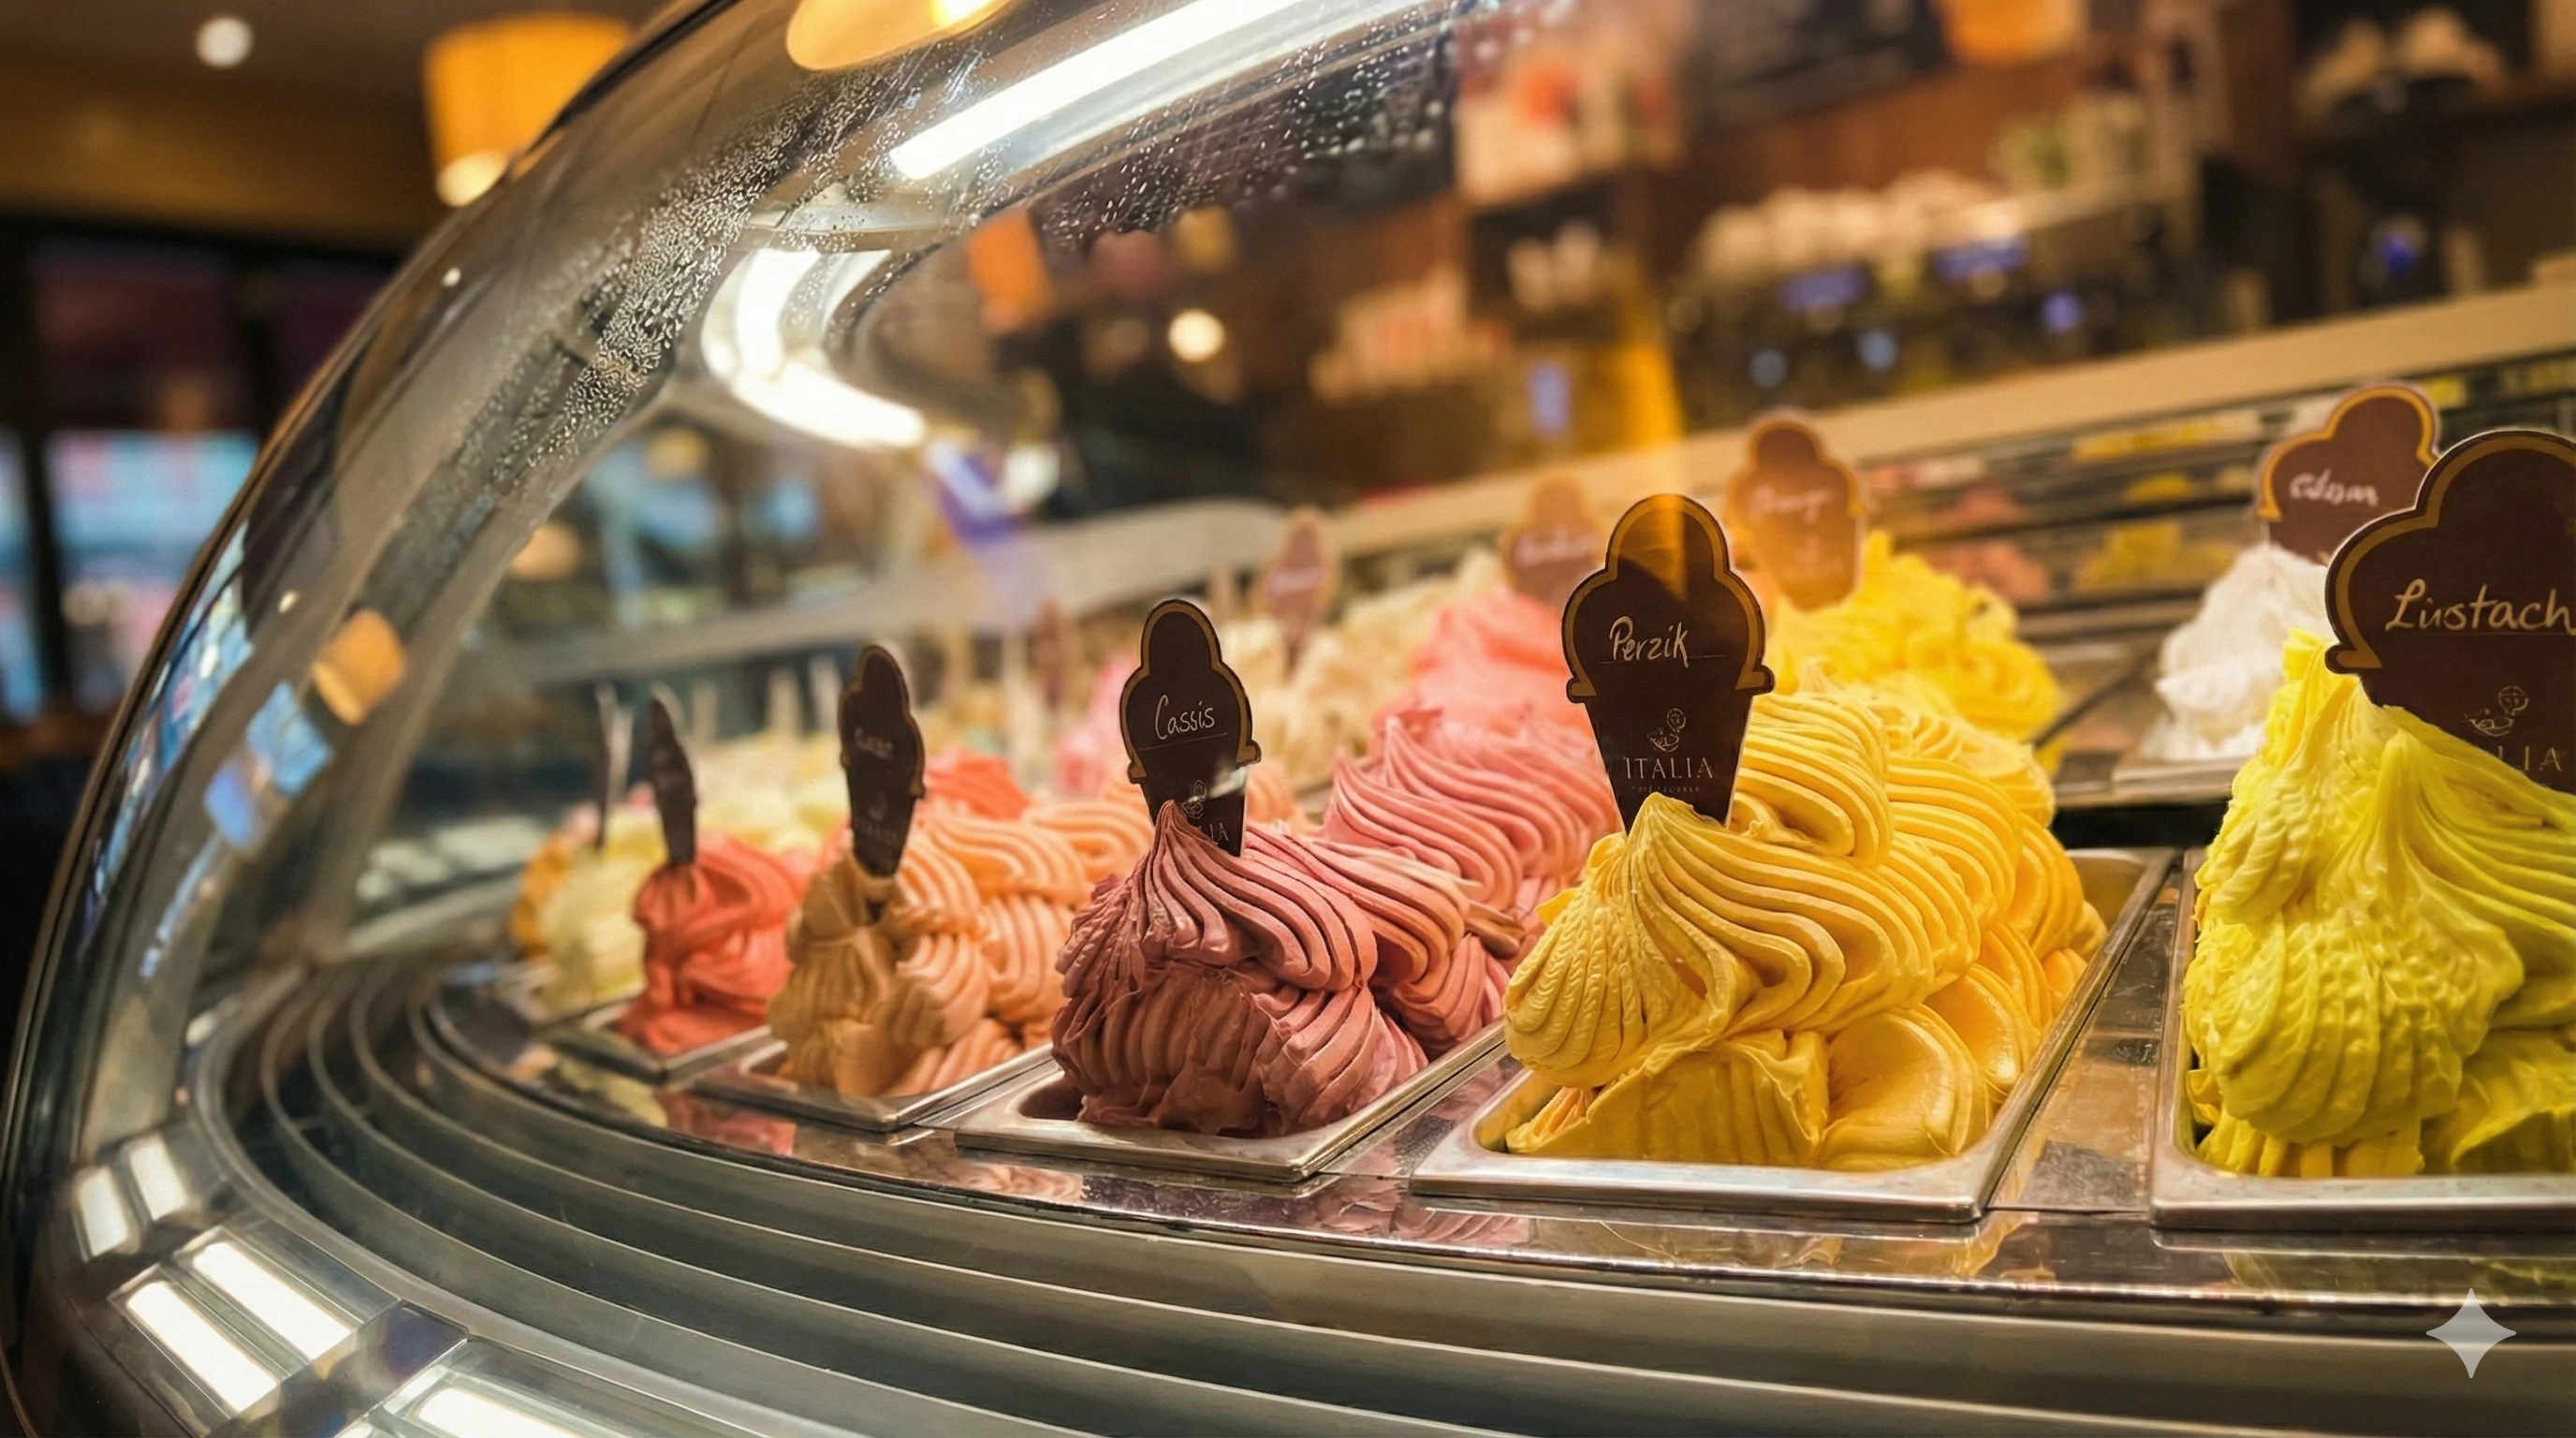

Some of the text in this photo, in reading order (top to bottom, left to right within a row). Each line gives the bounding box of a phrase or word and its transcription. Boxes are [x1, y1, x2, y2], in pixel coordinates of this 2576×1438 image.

[1608, 615, 1689, 668] Perzik
[1154, 694, 1216, 740] Cassis
[1622, 756, 1713, 779] ITALIA
